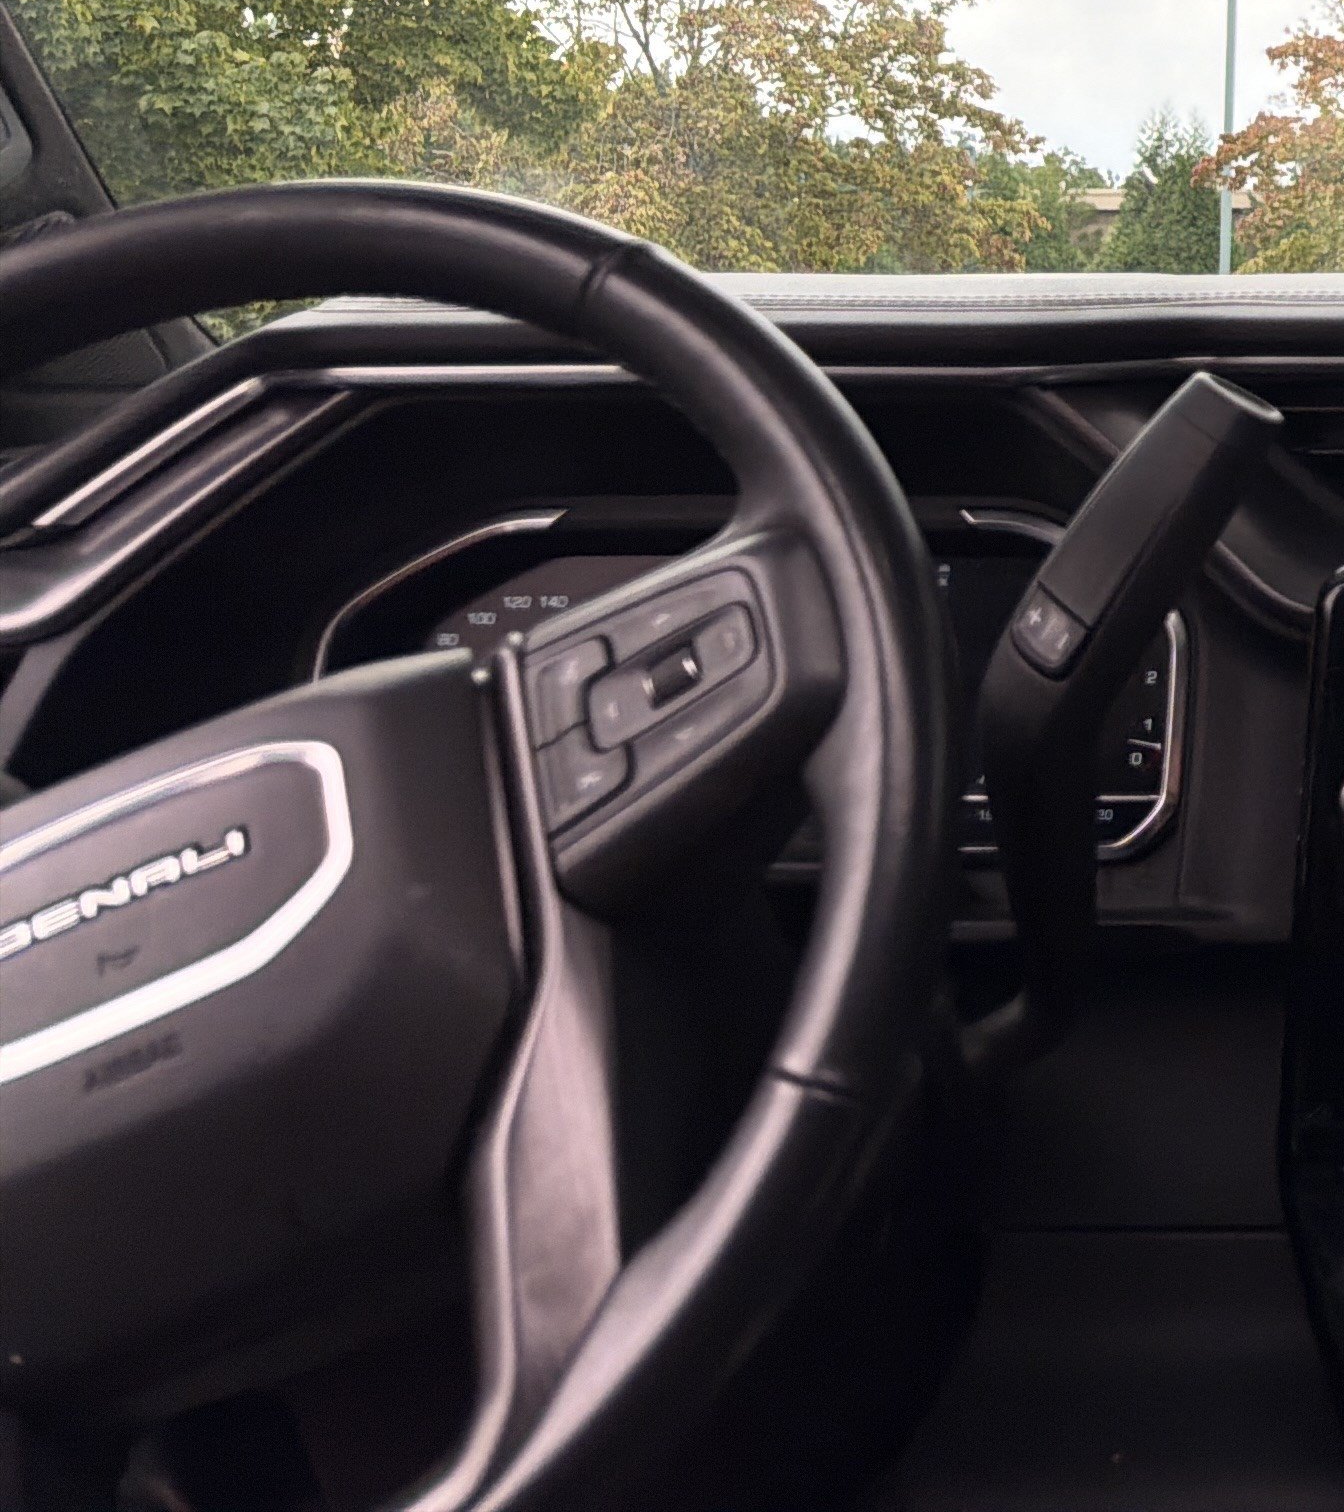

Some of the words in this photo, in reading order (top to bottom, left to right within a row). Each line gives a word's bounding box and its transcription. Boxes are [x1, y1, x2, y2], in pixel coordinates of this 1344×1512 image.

[504, 595, 532, 608] 120
[540, 595, 569, 608] 140
[467, 612, 497, 625] 100
[1145, 670, 1158, 684] 2
[1143, 718, 1153, 731] 1
[1129, 752, 1142, 765] 0
